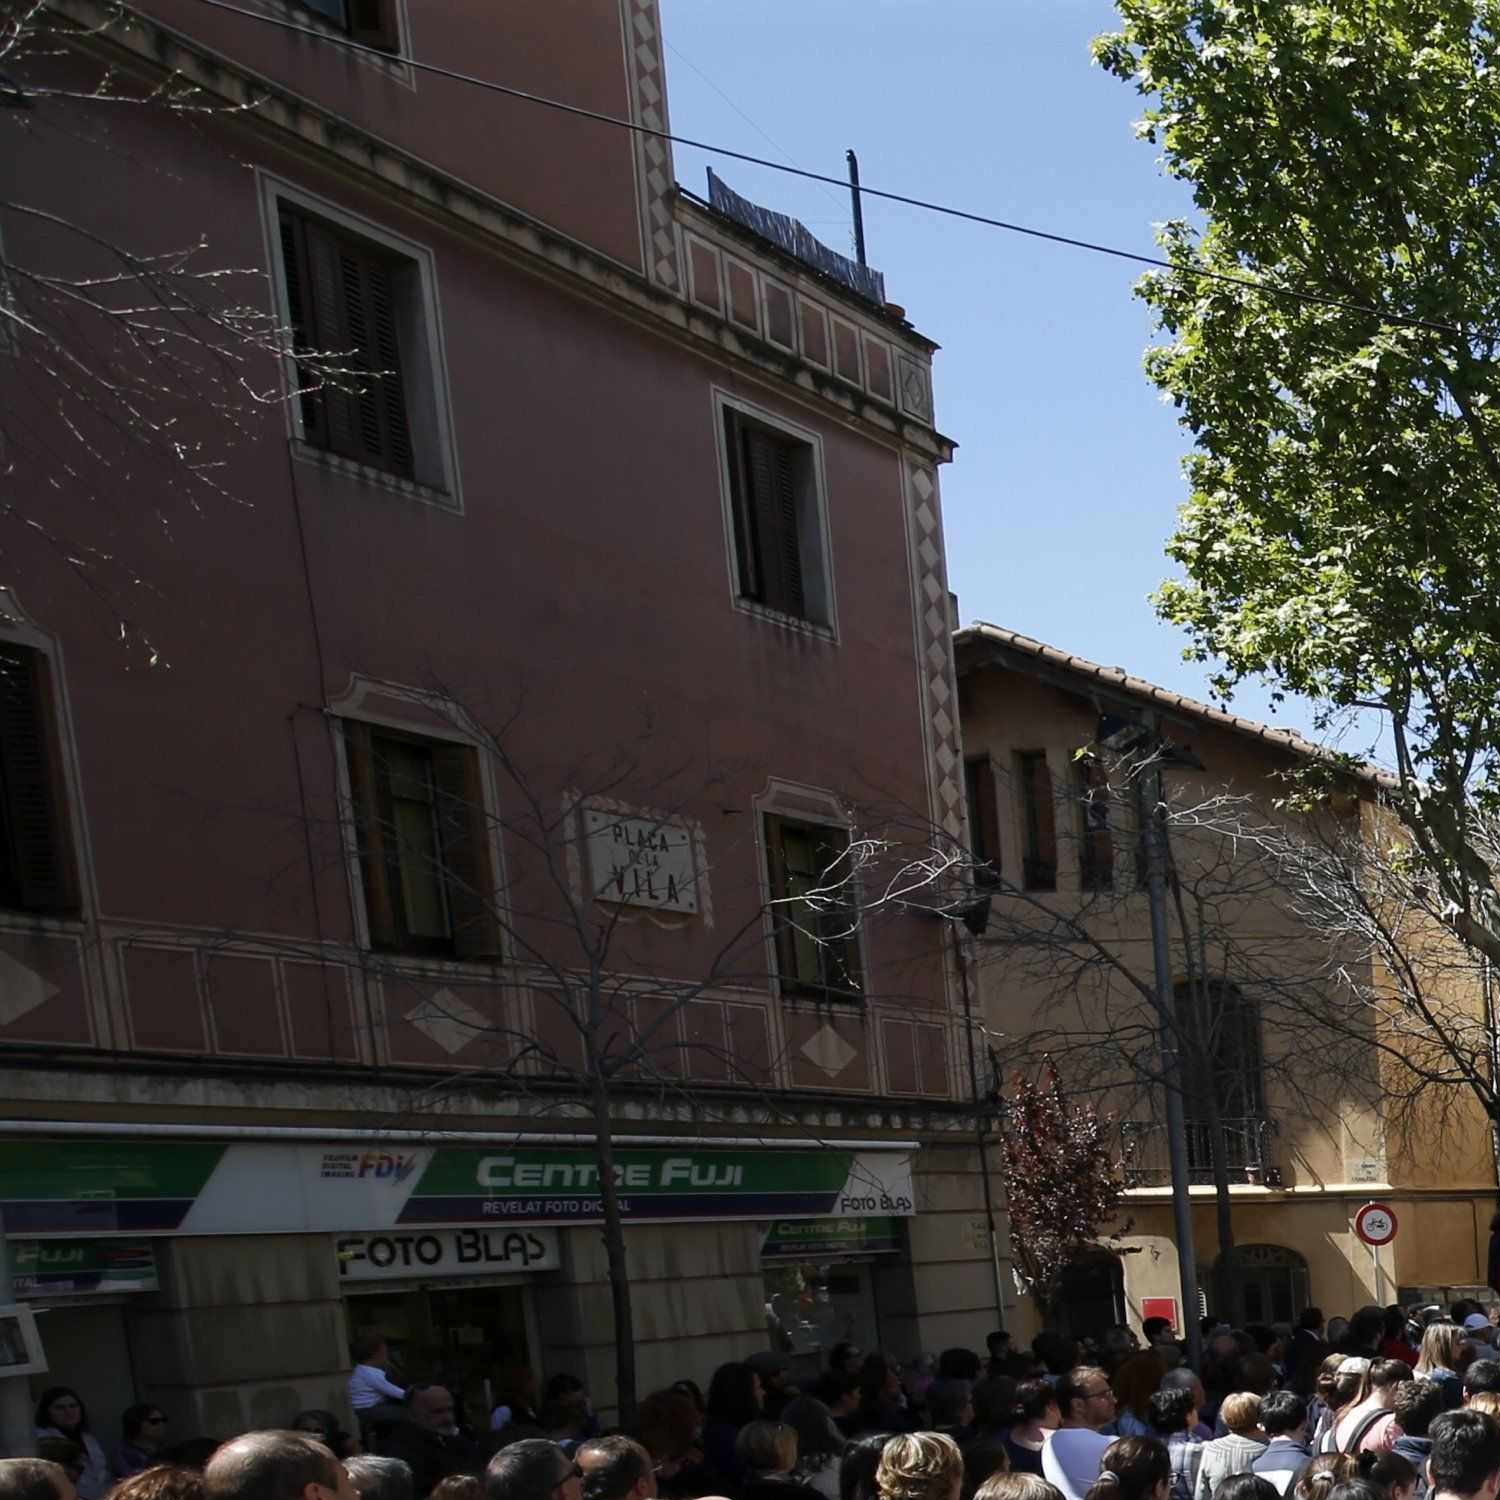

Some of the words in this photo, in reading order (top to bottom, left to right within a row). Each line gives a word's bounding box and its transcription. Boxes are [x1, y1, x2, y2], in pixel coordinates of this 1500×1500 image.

[612, 863, 679, 905] VILA
[659, 1157, 744, 1187] FUJI
[482, 1201, 542, 1215] REVELAT
[544, 1200, 577, 1213] FOTO
[582, 1199, 632, 1213] DIGAL
[841, 1196, 876, 1213] FOTO
[337, 1236, 442, 1275] FOTO
[456, 1228, 545, 1266] BLAS
